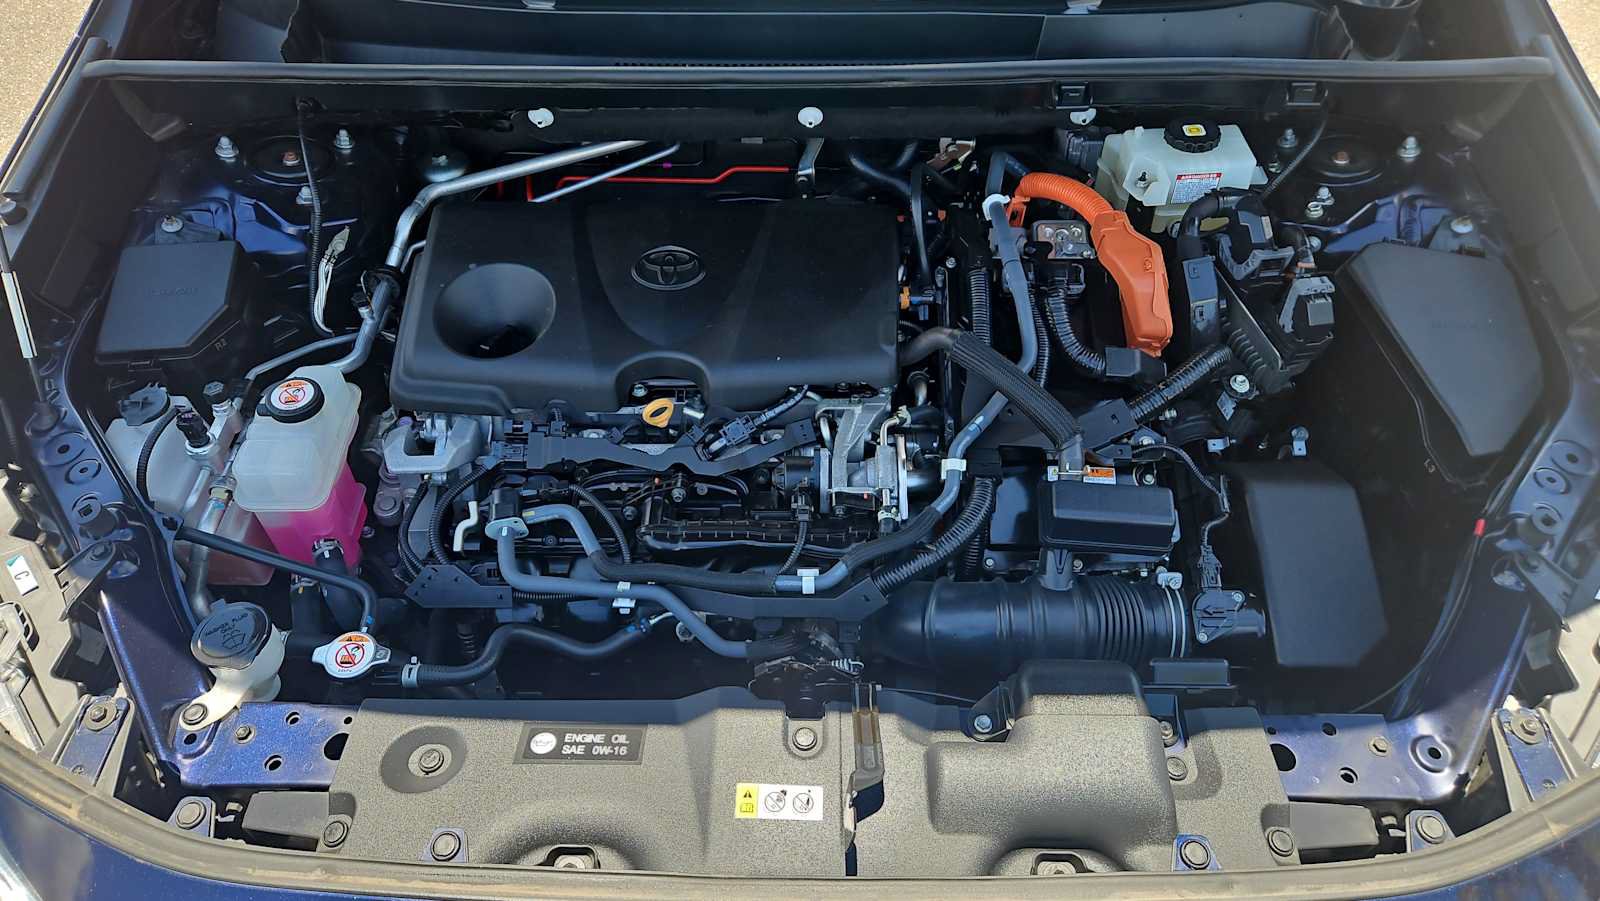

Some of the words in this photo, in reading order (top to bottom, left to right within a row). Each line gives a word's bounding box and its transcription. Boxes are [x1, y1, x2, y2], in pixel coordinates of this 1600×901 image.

[564, 733, 606, 743] ENGINE
[611, 734, 630, 744] OIL
[561, 745, 586, 755] SAE
[592, 746, 627, 755] 0W-16
